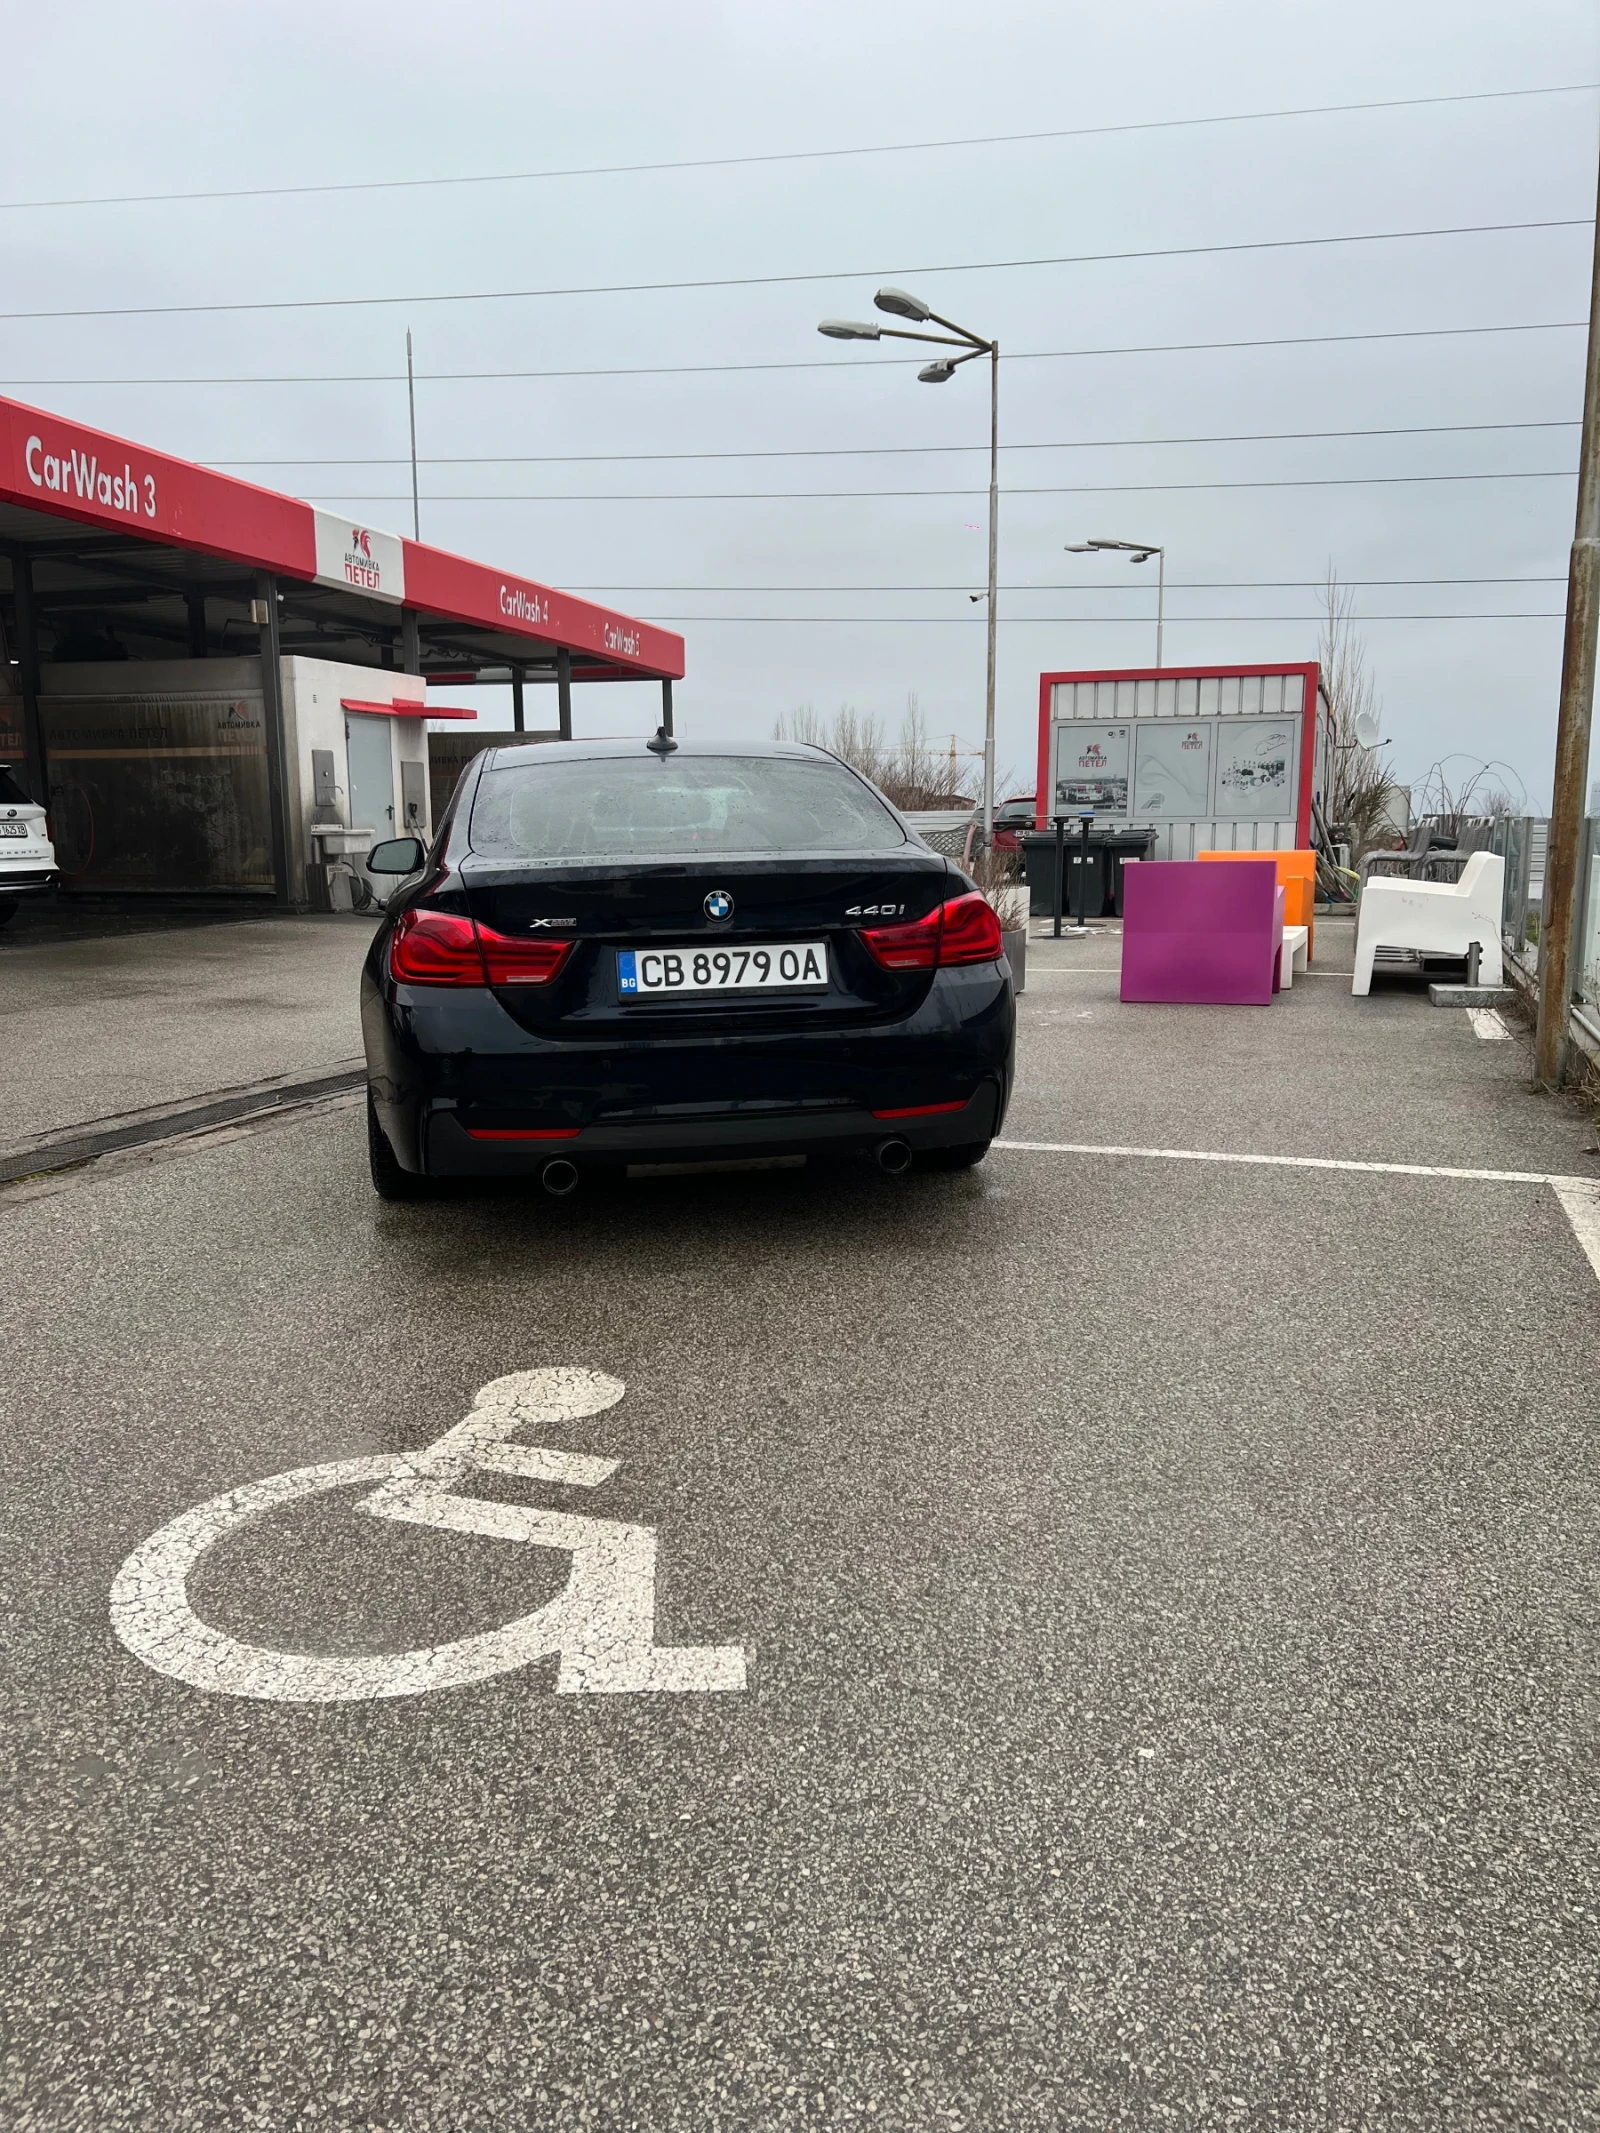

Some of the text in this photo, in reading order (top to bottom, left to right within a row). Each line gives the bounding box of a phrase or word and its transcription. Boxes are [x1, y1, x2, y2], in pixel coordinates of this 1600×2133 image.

[26, 435, 156, 518] CarWash 3
[344, 552, 380, 571] АВТОМИВКА
[344, 562, 380, 590] ПЕТЕЛ
[500, 584, 549, 626] CarWash 4
[604, 622, 636, 655] CarWash
[217, 720, 261, 729] АВТОМИВКА
[129, 727, 169, 740] ПЕТЕЛ
[1078, 759, 1108, 768] ПЕТЕЛ
[706, 891, 731, 903] BMW
[844, 904, 905, 917] 440i
[642, 954, 685, 987] CB
[692, 950, 771, 985] 8979
[621, 978, 636, 988] BG
